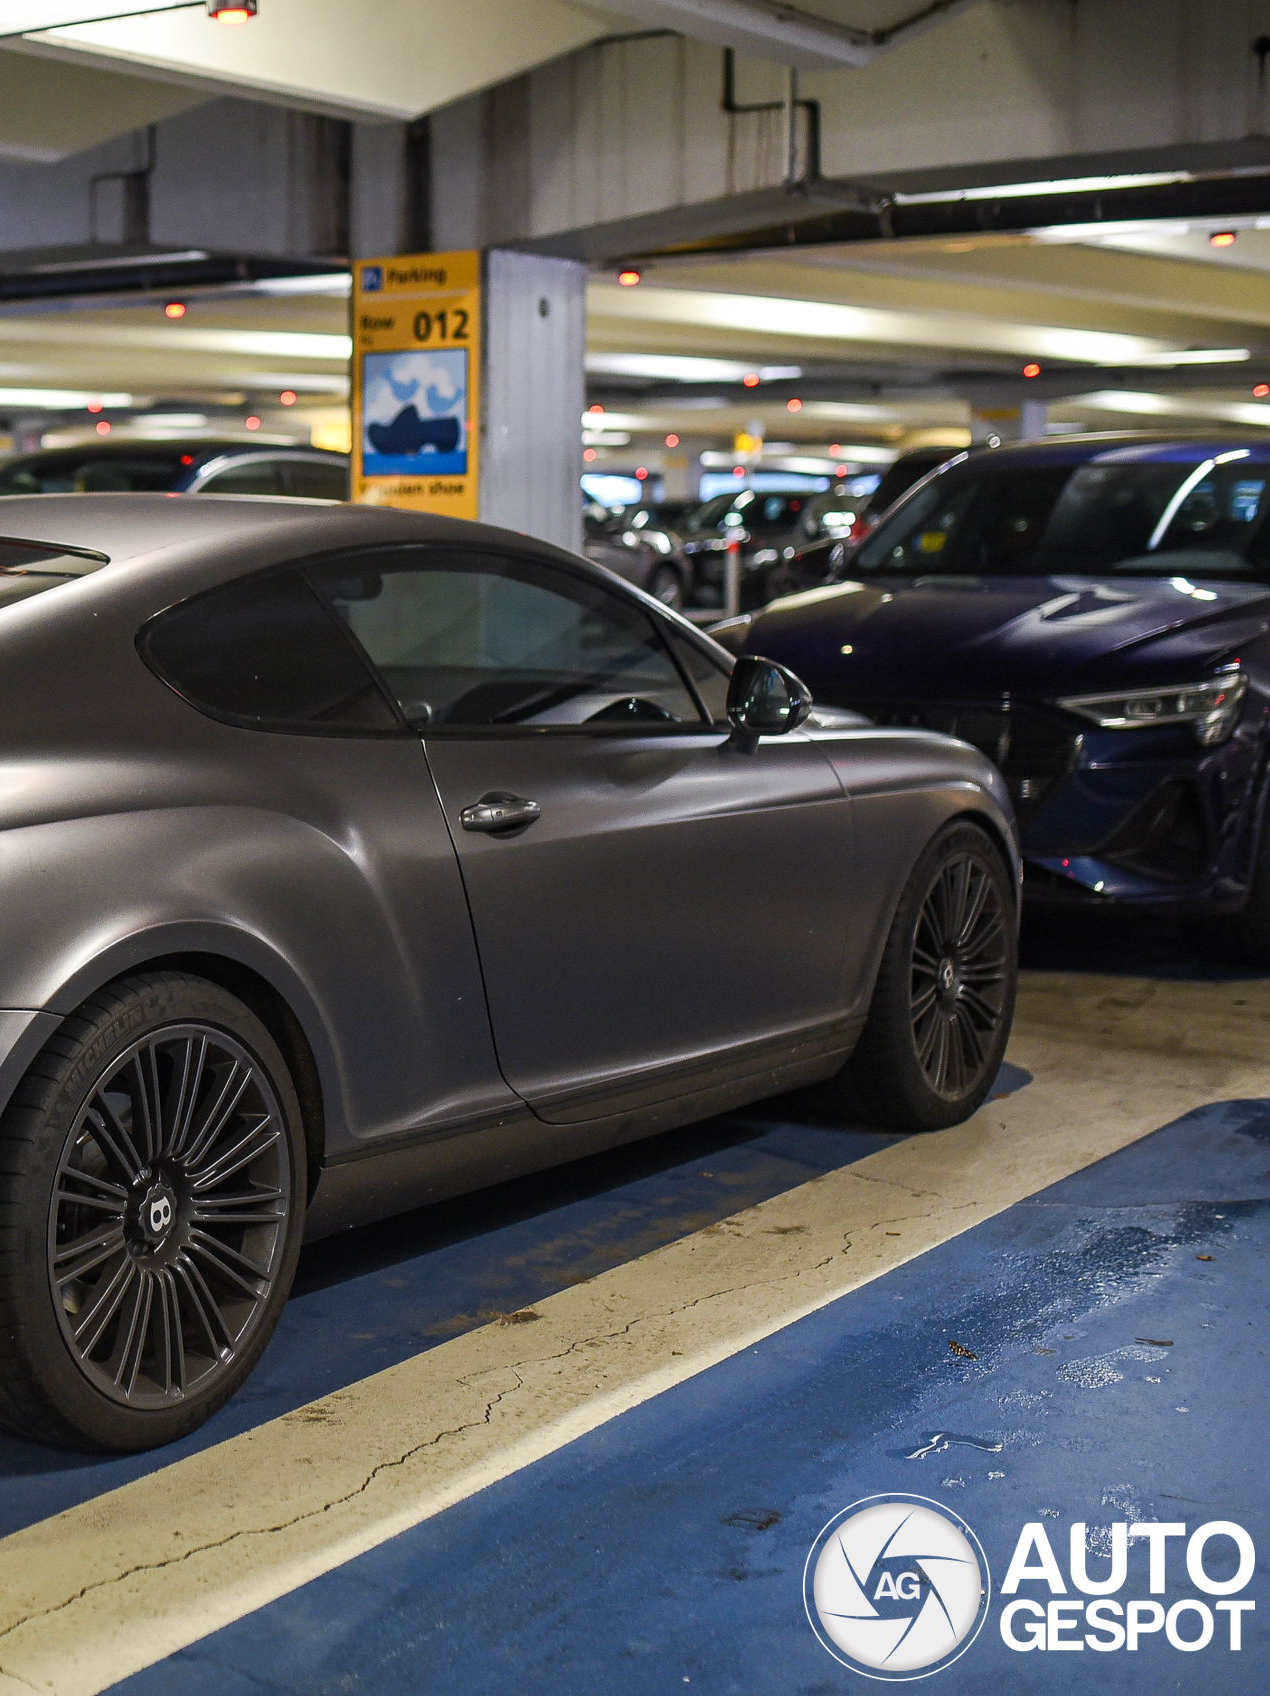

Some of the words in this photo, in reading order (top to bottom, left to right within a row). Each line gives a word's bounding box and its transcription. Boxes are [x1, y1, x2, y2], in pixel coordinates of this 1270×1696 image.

[387, 268, 447, 286] Parking
[412, 308, 469, 342] 012
[64, 1002, 146, 1100] MICHELIN
[150, 1196, 172, 1232] B
